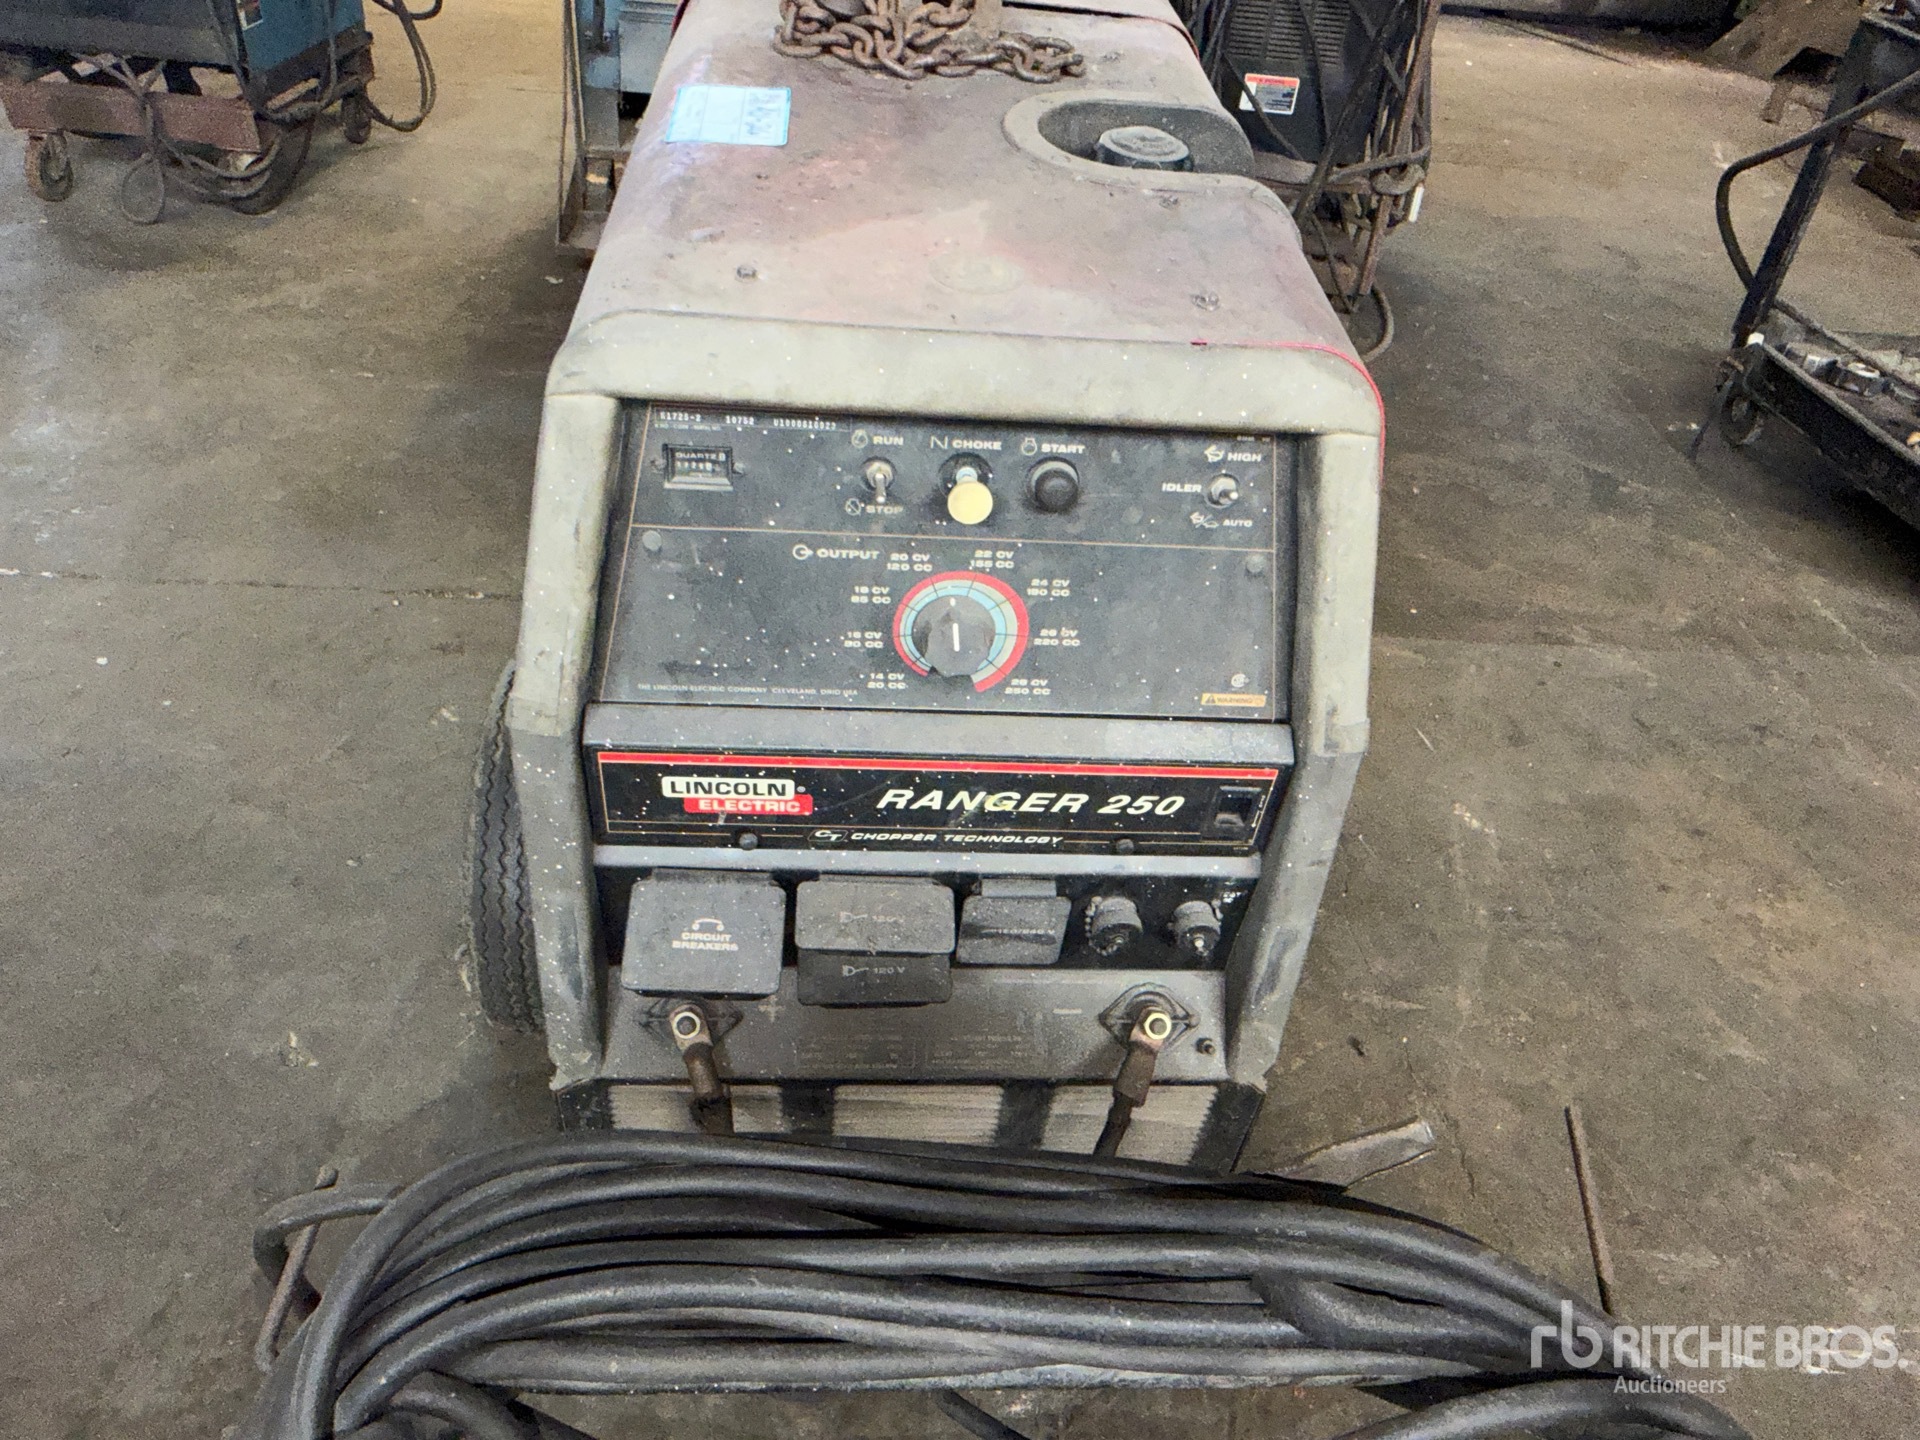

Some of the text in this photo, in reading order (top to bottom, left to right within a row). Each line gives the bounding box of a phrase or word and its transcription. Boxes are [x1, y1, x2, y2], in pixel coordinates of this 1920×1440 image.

[873, 436, 904, 445] RUN
[952, 440, 1002, 450] CHOKE
[1041, 443, 1086, 454] START
[675, 452, 717, 460] QUARTZ
[1227, 452, 1262, 462] HIGH
[1162, 483, 1202, 493] IDLER
[866, 506, 904, 515] STOP
[1222, 519, 1253, 528] AUTO
[816, 548, 880, 560] OUTPUT
[890, 553, 930, 562] 20 CV
[974, 550, 1014, 559] 22 CV
[887, 563, 933, 572] 120 CC
[995, 560, 1014, 568] CC
[1031, 578, 1070, 587] 24 CV
[871, 586, 890, 594] CV
[1051, 589, 1070, 597] CC
[871, 596, 891, 604] CC
[864, 631, 882, 639] CV
[1060, 629, 1078, 637] CV
[864, 640, 883, 648] CC
[727, 686, 767, 694] COMPANY
[1005, 687, 1029, 695] 250
[670, 781, 787, 796] LINCOLN
[698, 799, 800, 813] ELECTRIC
[876, 789, 1186, 815] RANGER 250
[851, 832, 937, 842] CHOPPER
[943, 834, 1064, 845] TECHNOLOGY
[681, 932, 733, 942] CIRCUIT
[672, 941, 739, 951] BREAKERS
[897, 966, 906, 974] V
